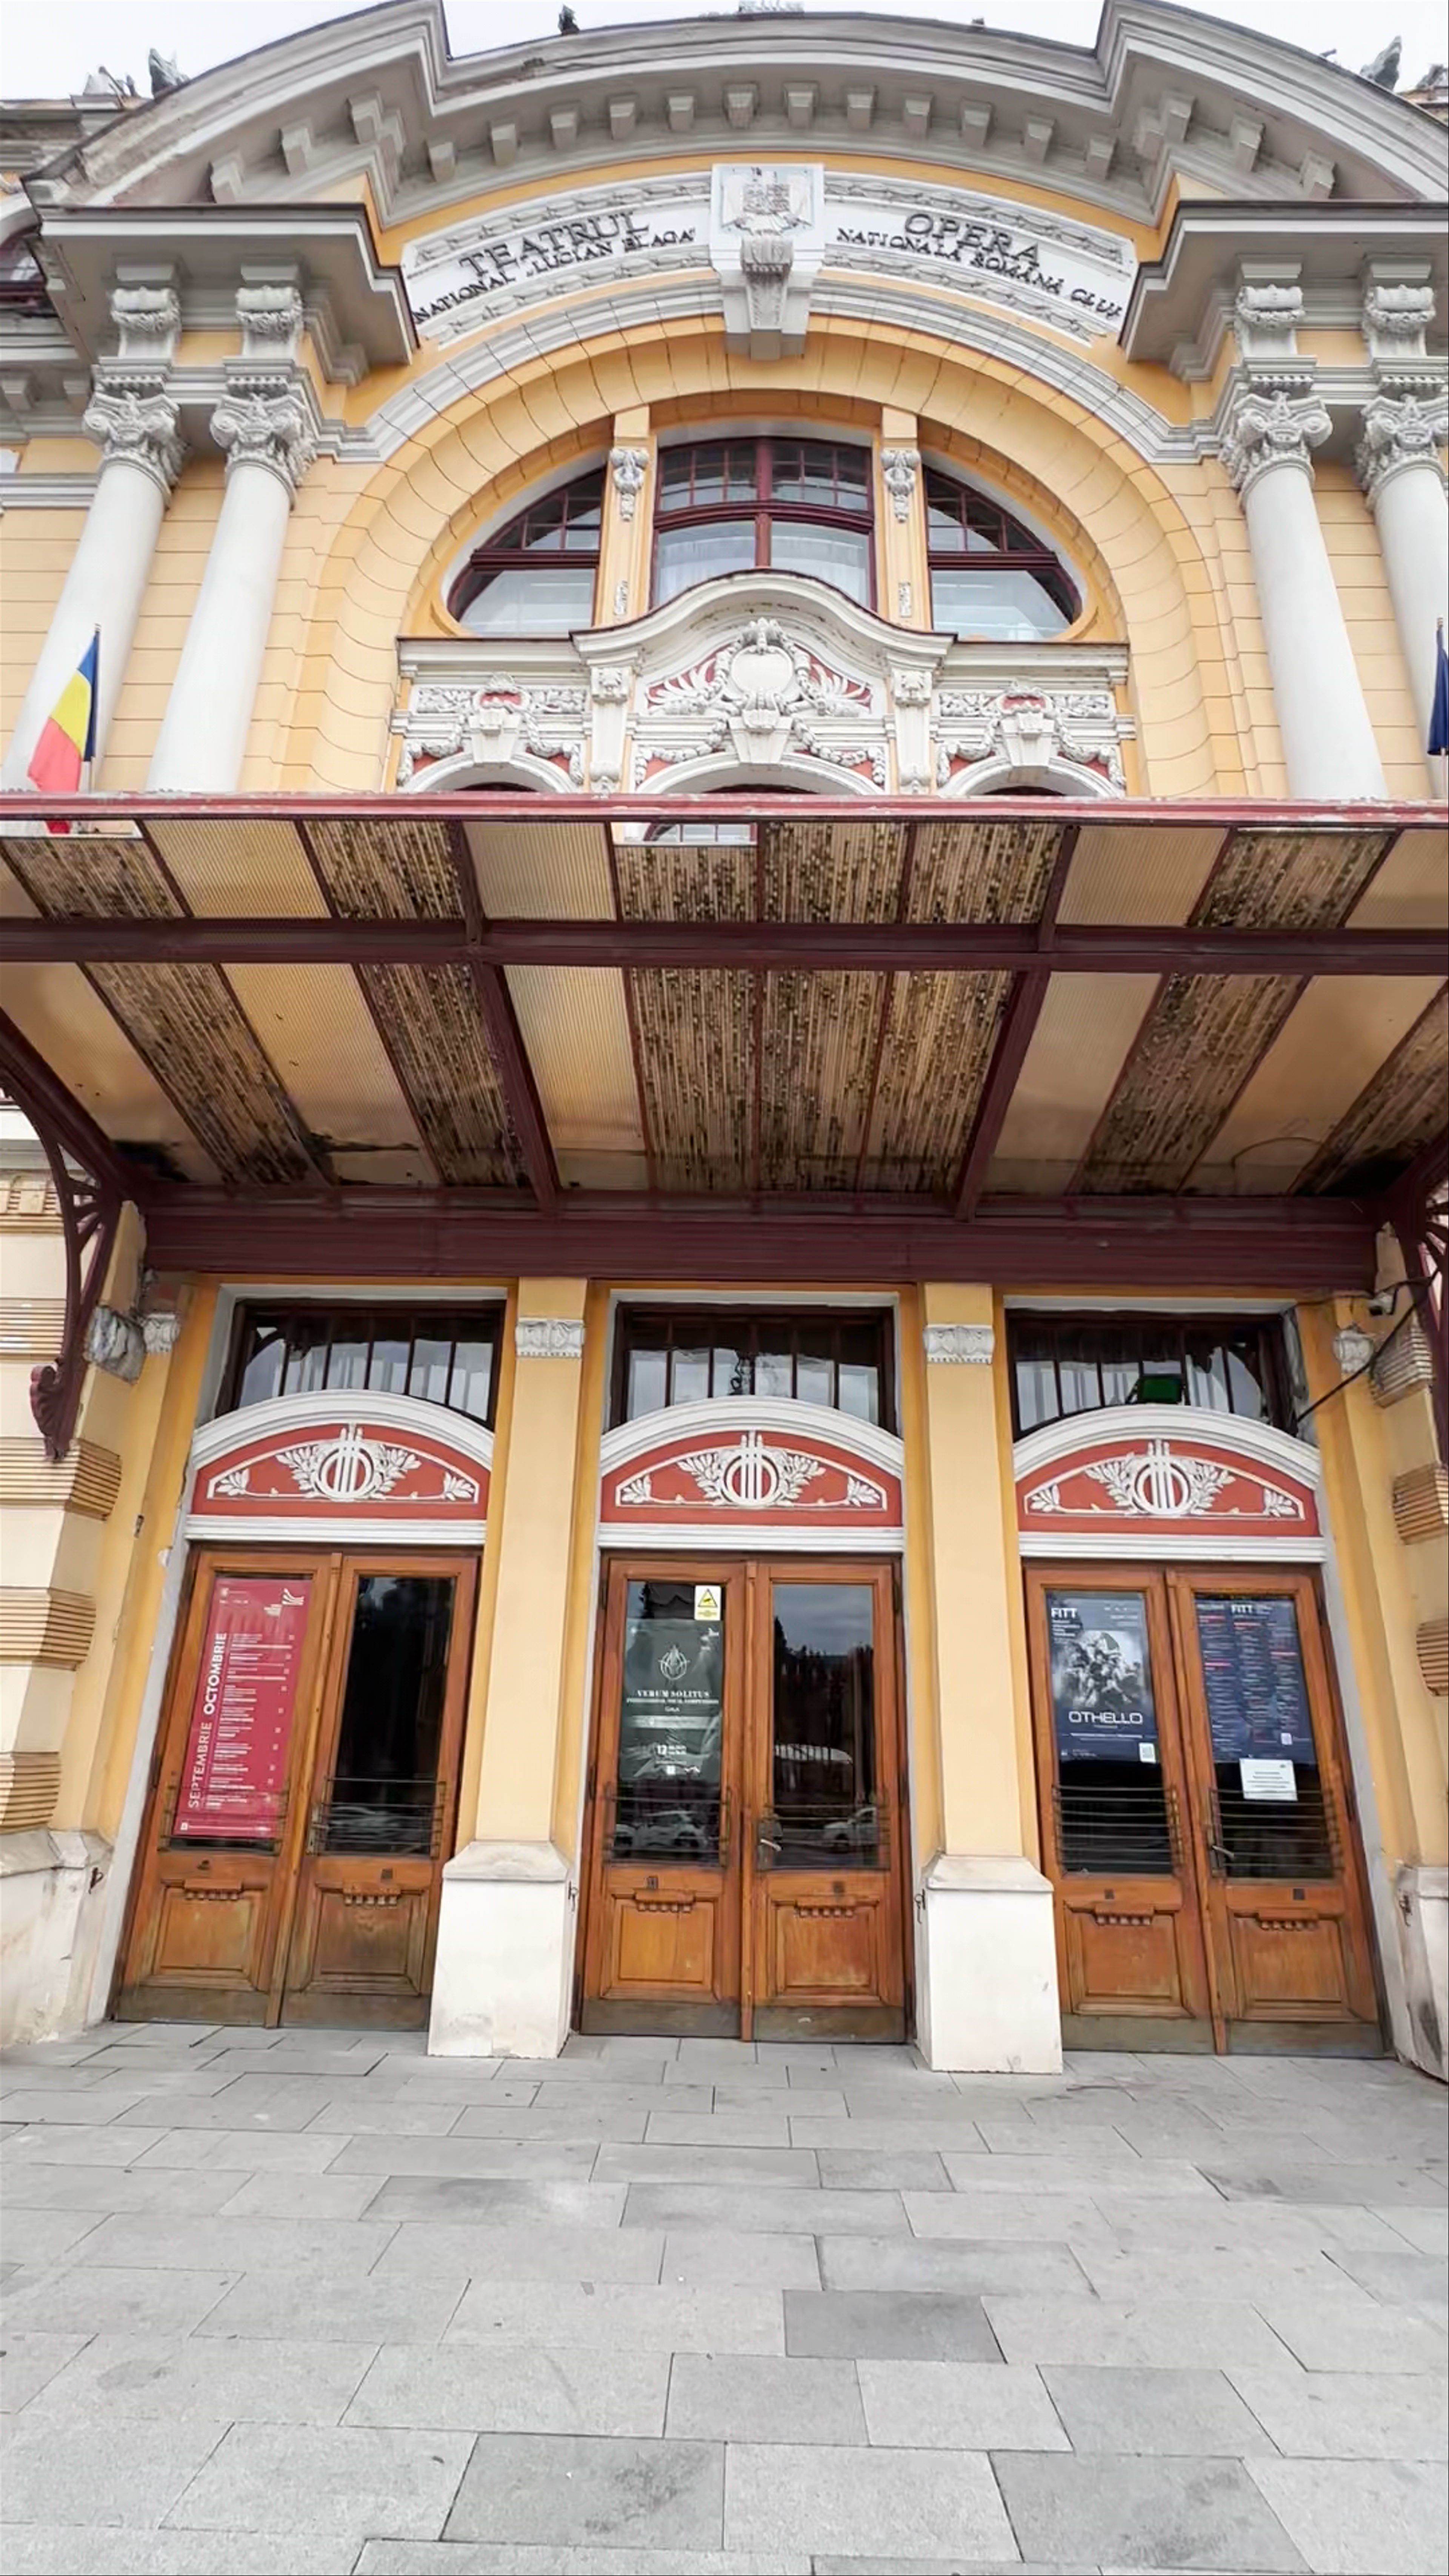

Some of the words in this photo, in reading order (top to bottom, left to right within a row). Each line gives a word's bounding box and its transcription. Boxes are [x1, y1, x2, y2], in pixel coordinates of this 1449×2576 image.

[459, 211, 649, 277] TEATRUL
[904, 214, 1040, 267] OPERA
[1071, 289, 1122, 318] CLUJ
[1051, 1608, 1077, 1618] FITT
[188, 1722, 212, 1808] SEPTEMBRIE
[203, 1633, 227, 1715] OCTOMBRIE
[1068, 1711, 1143, 1724] OTHELLO
